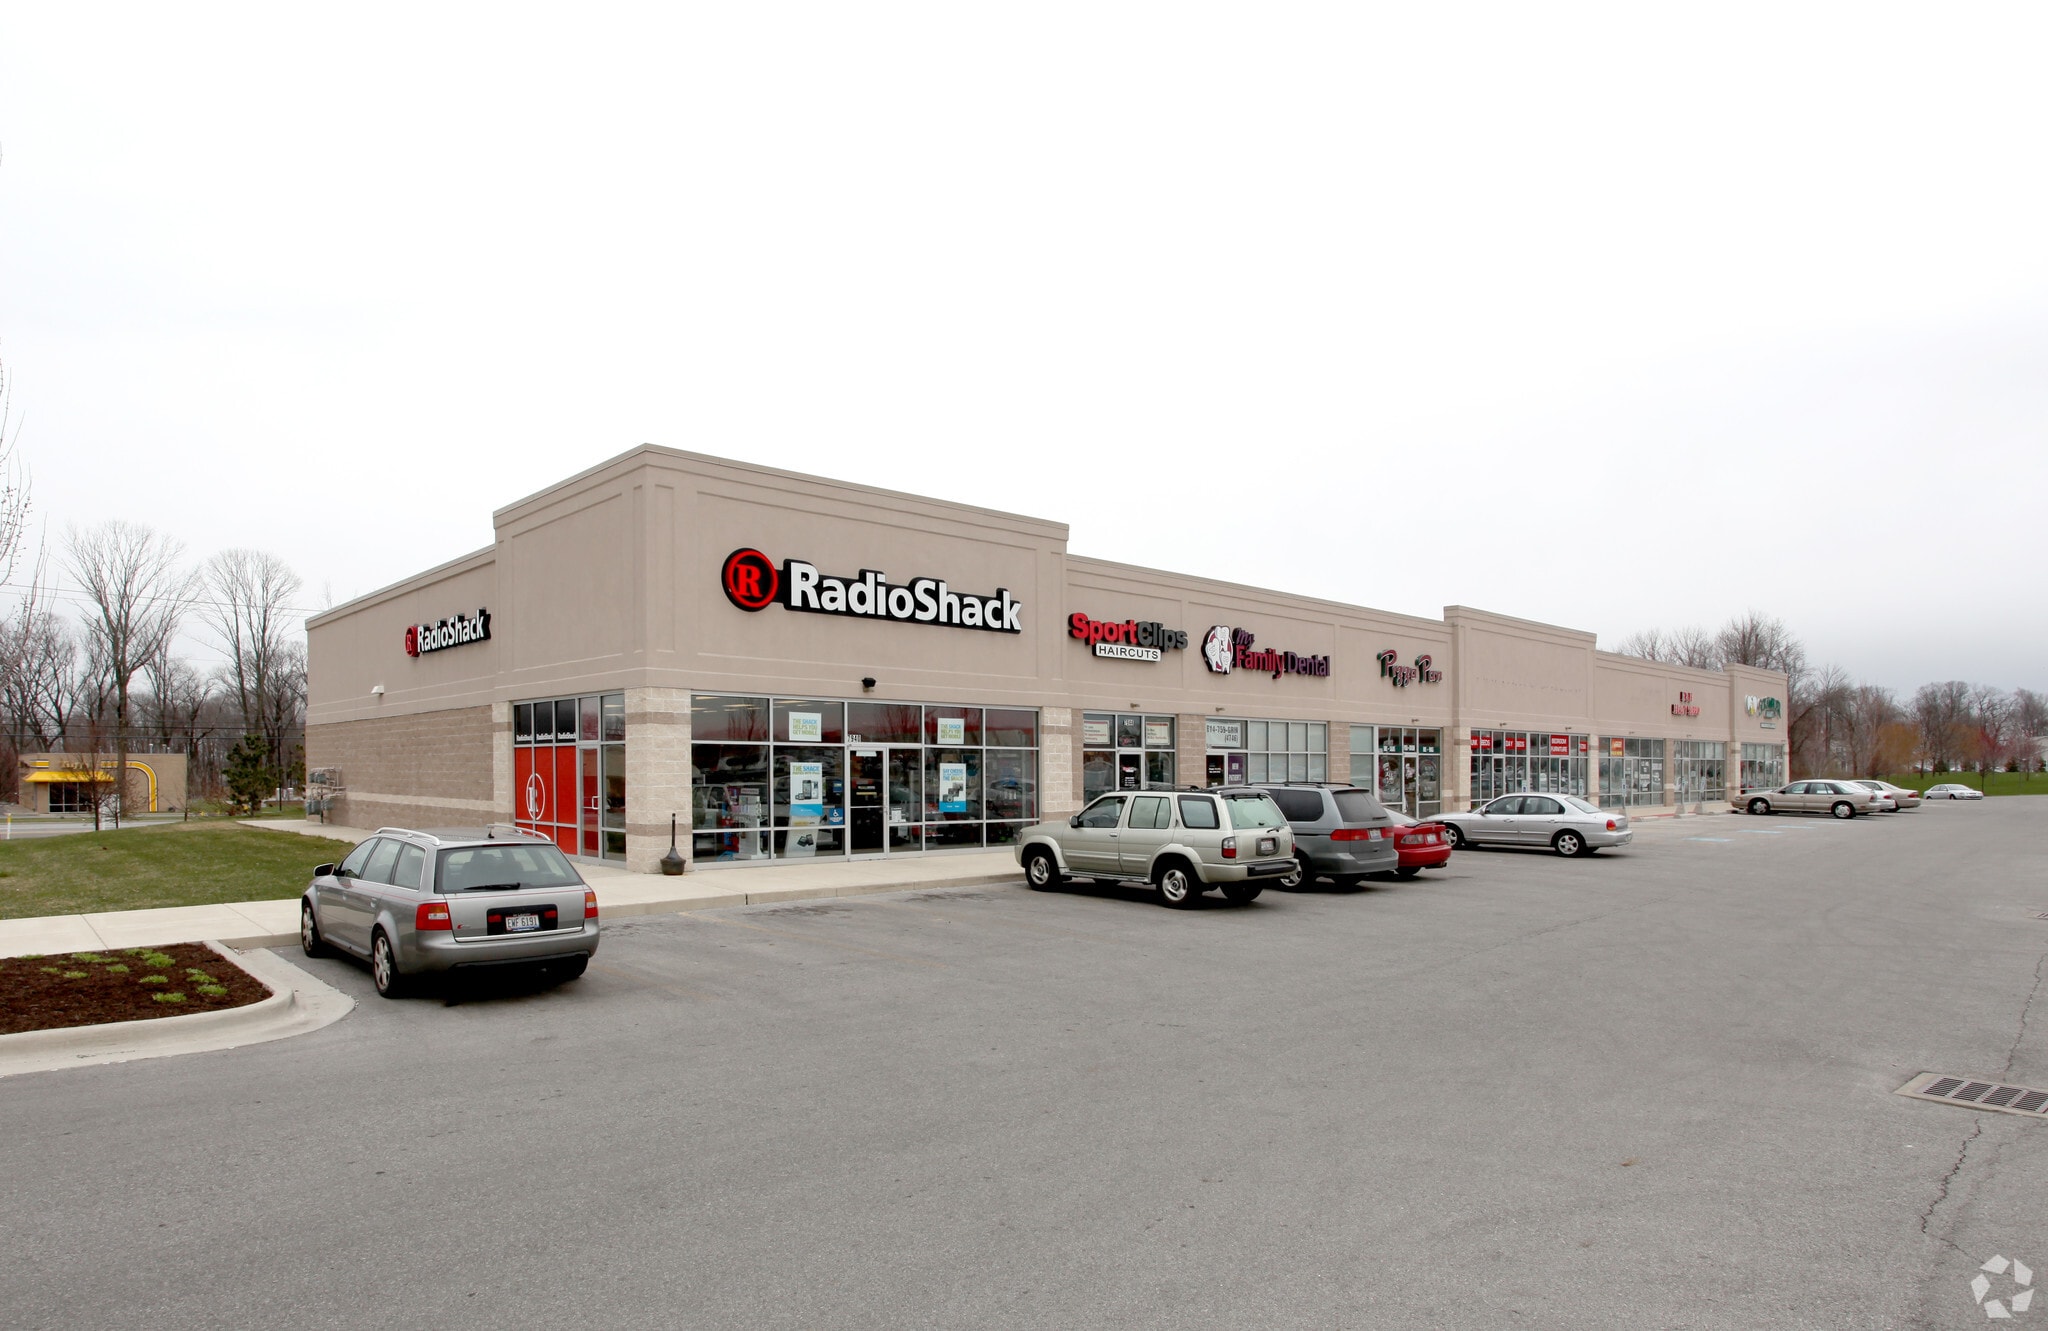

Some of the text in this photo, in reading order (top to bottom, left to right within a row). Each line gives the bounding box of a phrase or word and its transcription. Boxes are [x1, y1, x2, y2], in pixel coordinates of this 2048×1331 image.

[790, 561, 1022, 631] RadioShack
[417, 608, 485, 652] RadioShack
[1071, 612, 1188, 652] SportClips
[1098, 645, 1159, 660] HAIRCUTS
[1235, 644, 1331, 680] Family Dental
